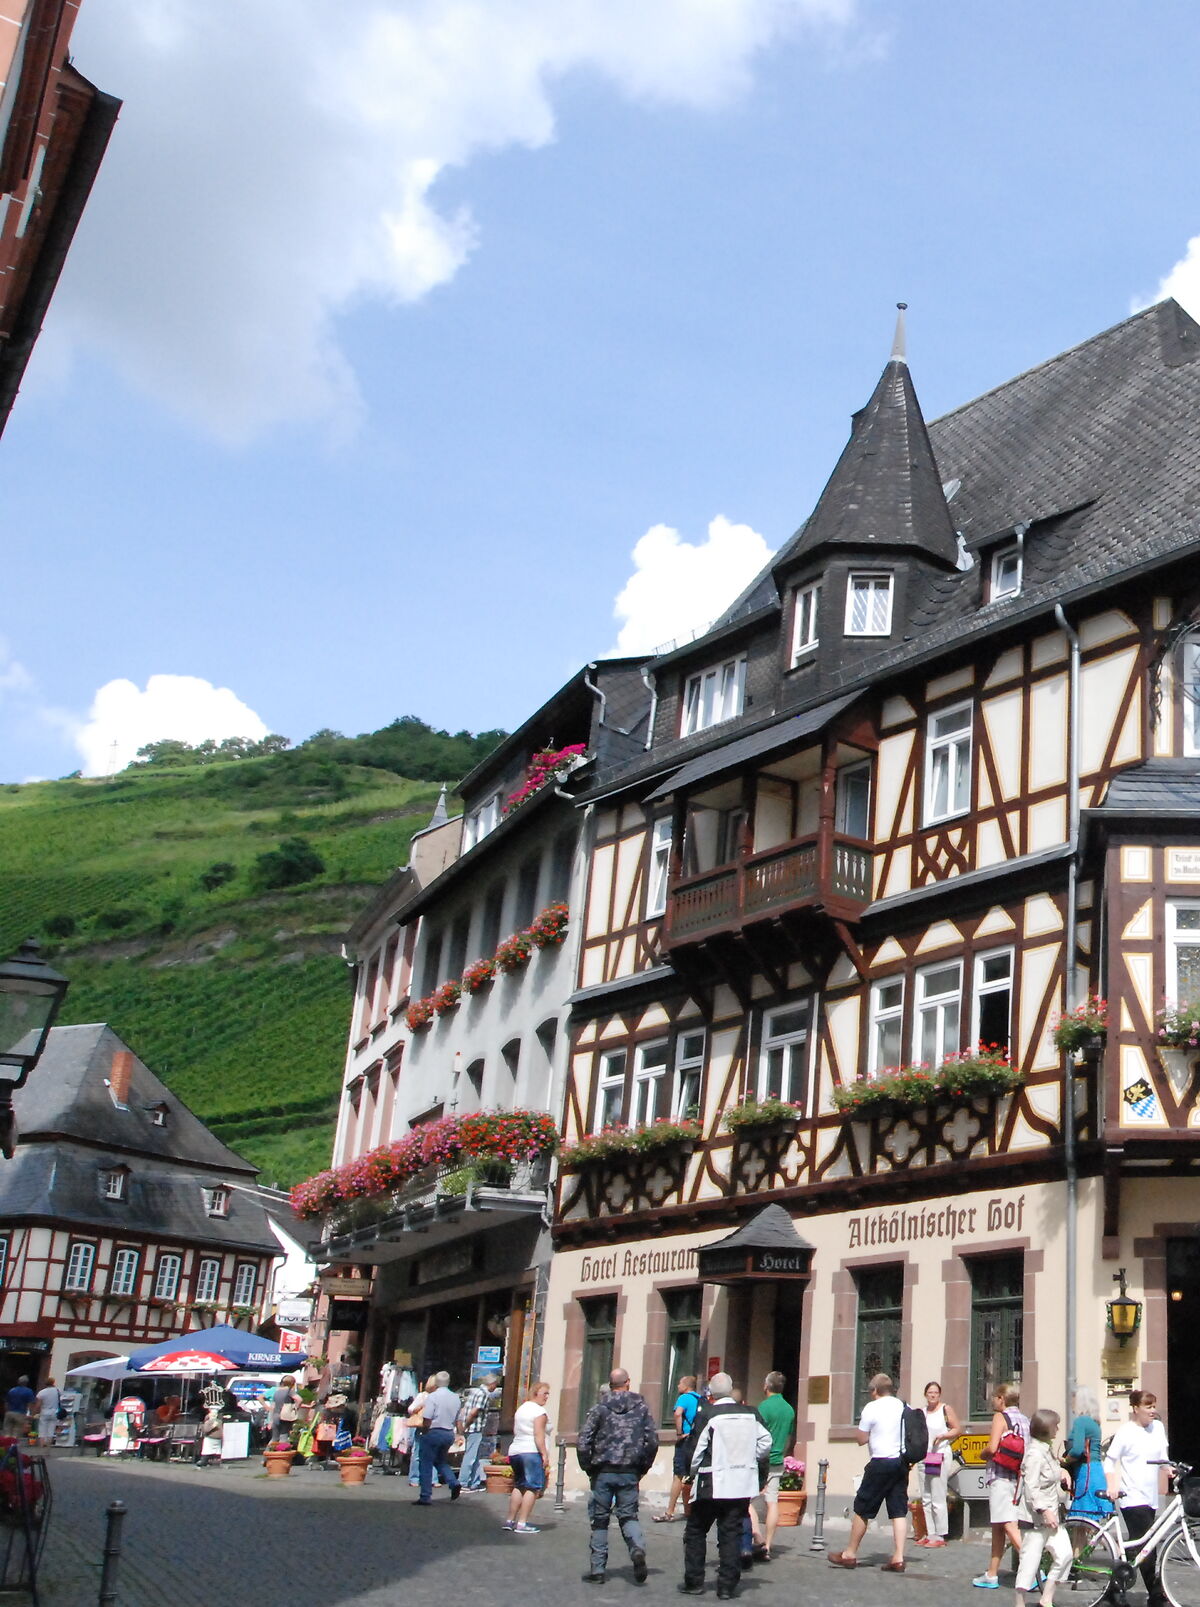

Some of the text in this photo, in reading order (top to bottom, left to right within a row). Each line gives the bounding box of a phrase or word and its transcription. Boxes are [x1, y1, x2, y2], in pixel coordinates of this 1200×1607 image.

[849, 1194, 1025, 1248] Altkölnischer Hof
[580, 1252, 617, 1282] Hotel
[759, 1250, 801, 1272] Hotel
[248, 1352, 282, 1362] KIRNER
[962, 1438, 989, 1450] Simm
